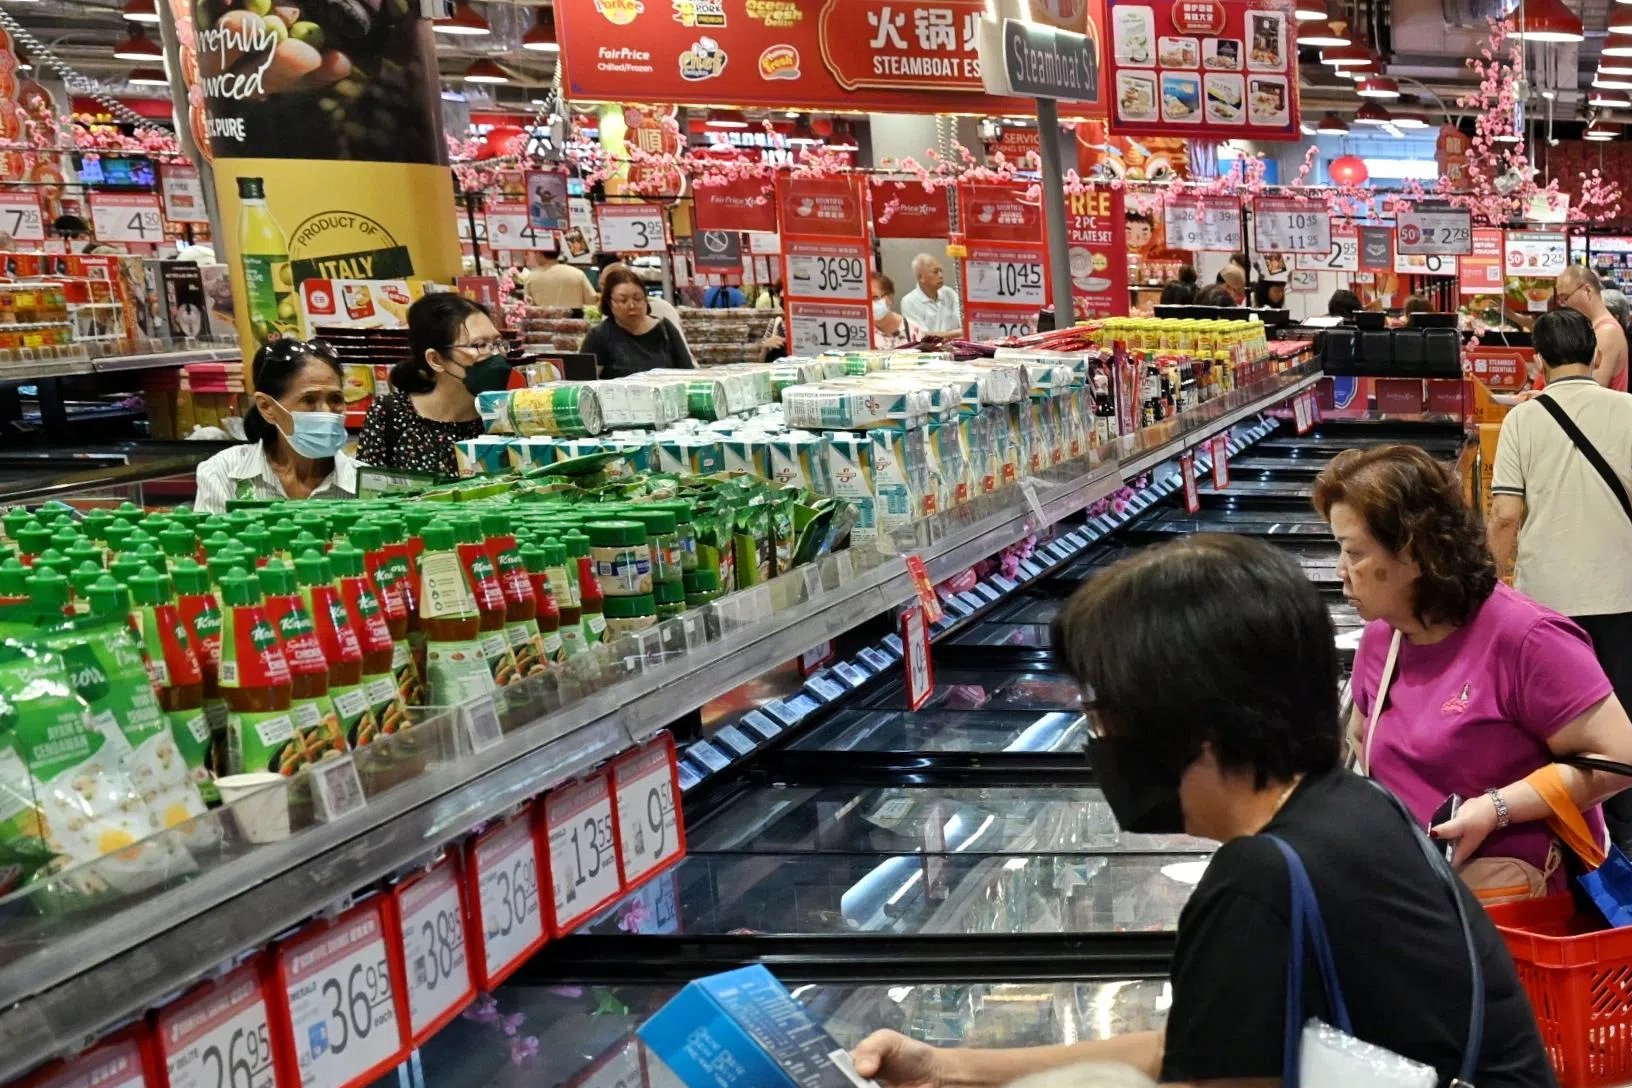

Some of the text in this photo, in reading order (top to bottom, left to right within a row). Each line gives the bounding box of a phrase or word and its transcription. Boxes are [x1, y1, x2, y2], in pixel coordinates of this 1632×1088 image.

[199, 18, 278, 68] refully
[598, 46, 650, 61] FairPrice
[597, 62, 653, 72] Chilled/Frozen
[872, 55, 981, 77] STEAMBOAT ES
[1012, 34, 1096, 91] Steamboat St
[200, 65, 266, 99] urced
[215, 117, 248, 142] PURE
[1004, 132, 1041, 144] SERVIC
[297, 216, 379, 247] PRODUCT OF
[1075, 216, 1097, 229] 2 PC
[1072, 231, 1112, 242] PLATE SET
[318, 255, 375, 280] ITALY
